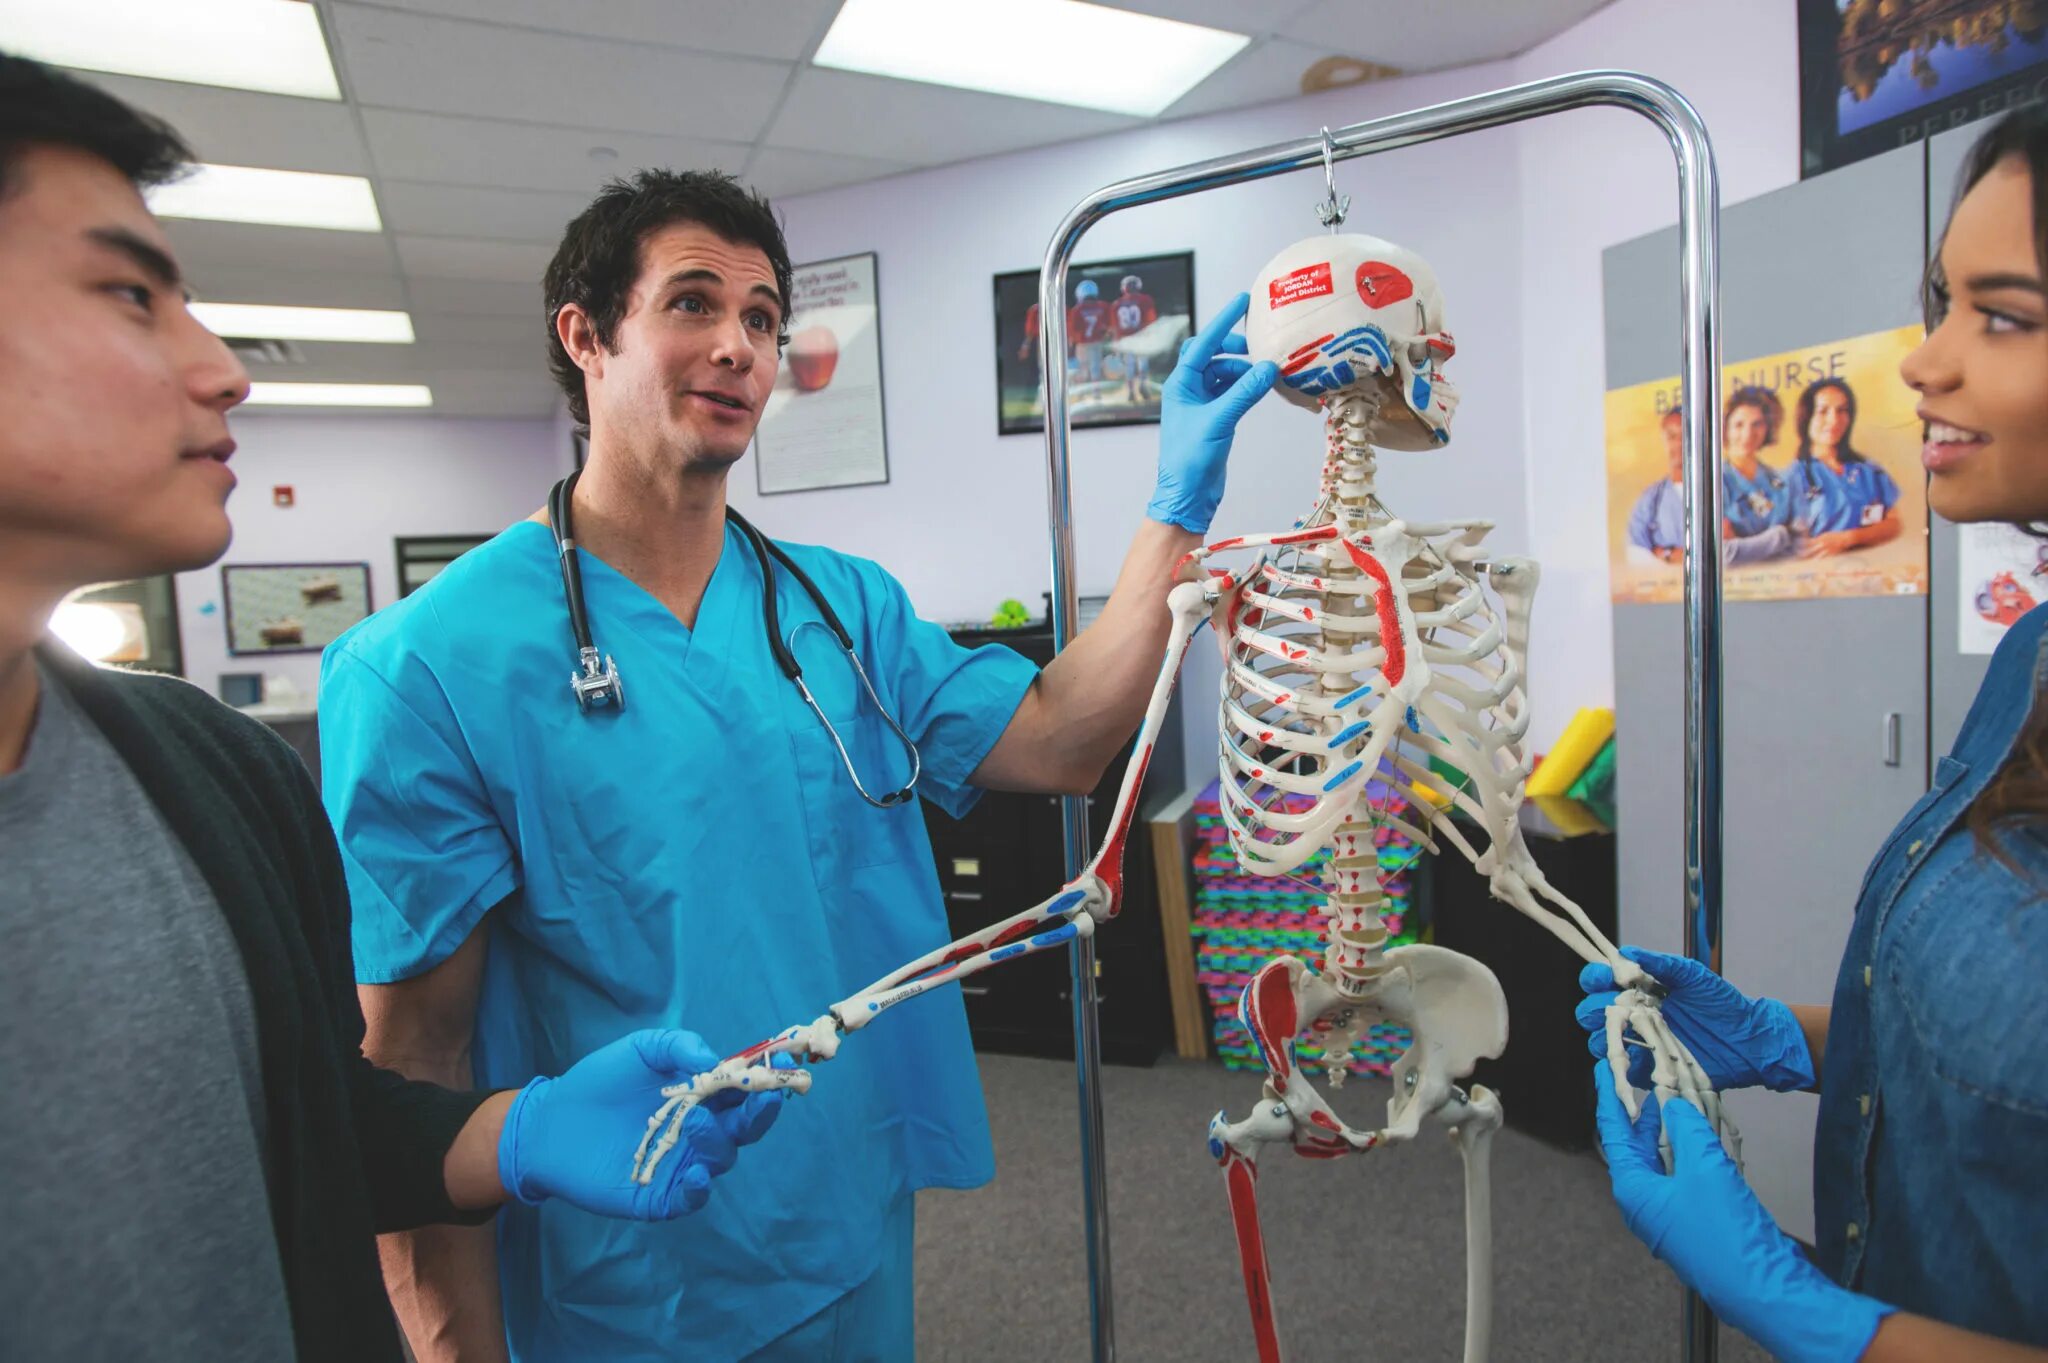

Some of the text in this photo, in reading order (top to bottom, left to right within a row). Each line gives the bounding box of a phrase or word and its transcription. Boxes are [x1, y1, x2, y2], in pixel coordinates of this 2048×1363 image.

[1278, 270, 1319, 286] Property of
[1284, 280, 1313, 293] JORDAN
[1275, 284, 1326, 304] School District
[1732, 351, 1847, 395] NURSE
